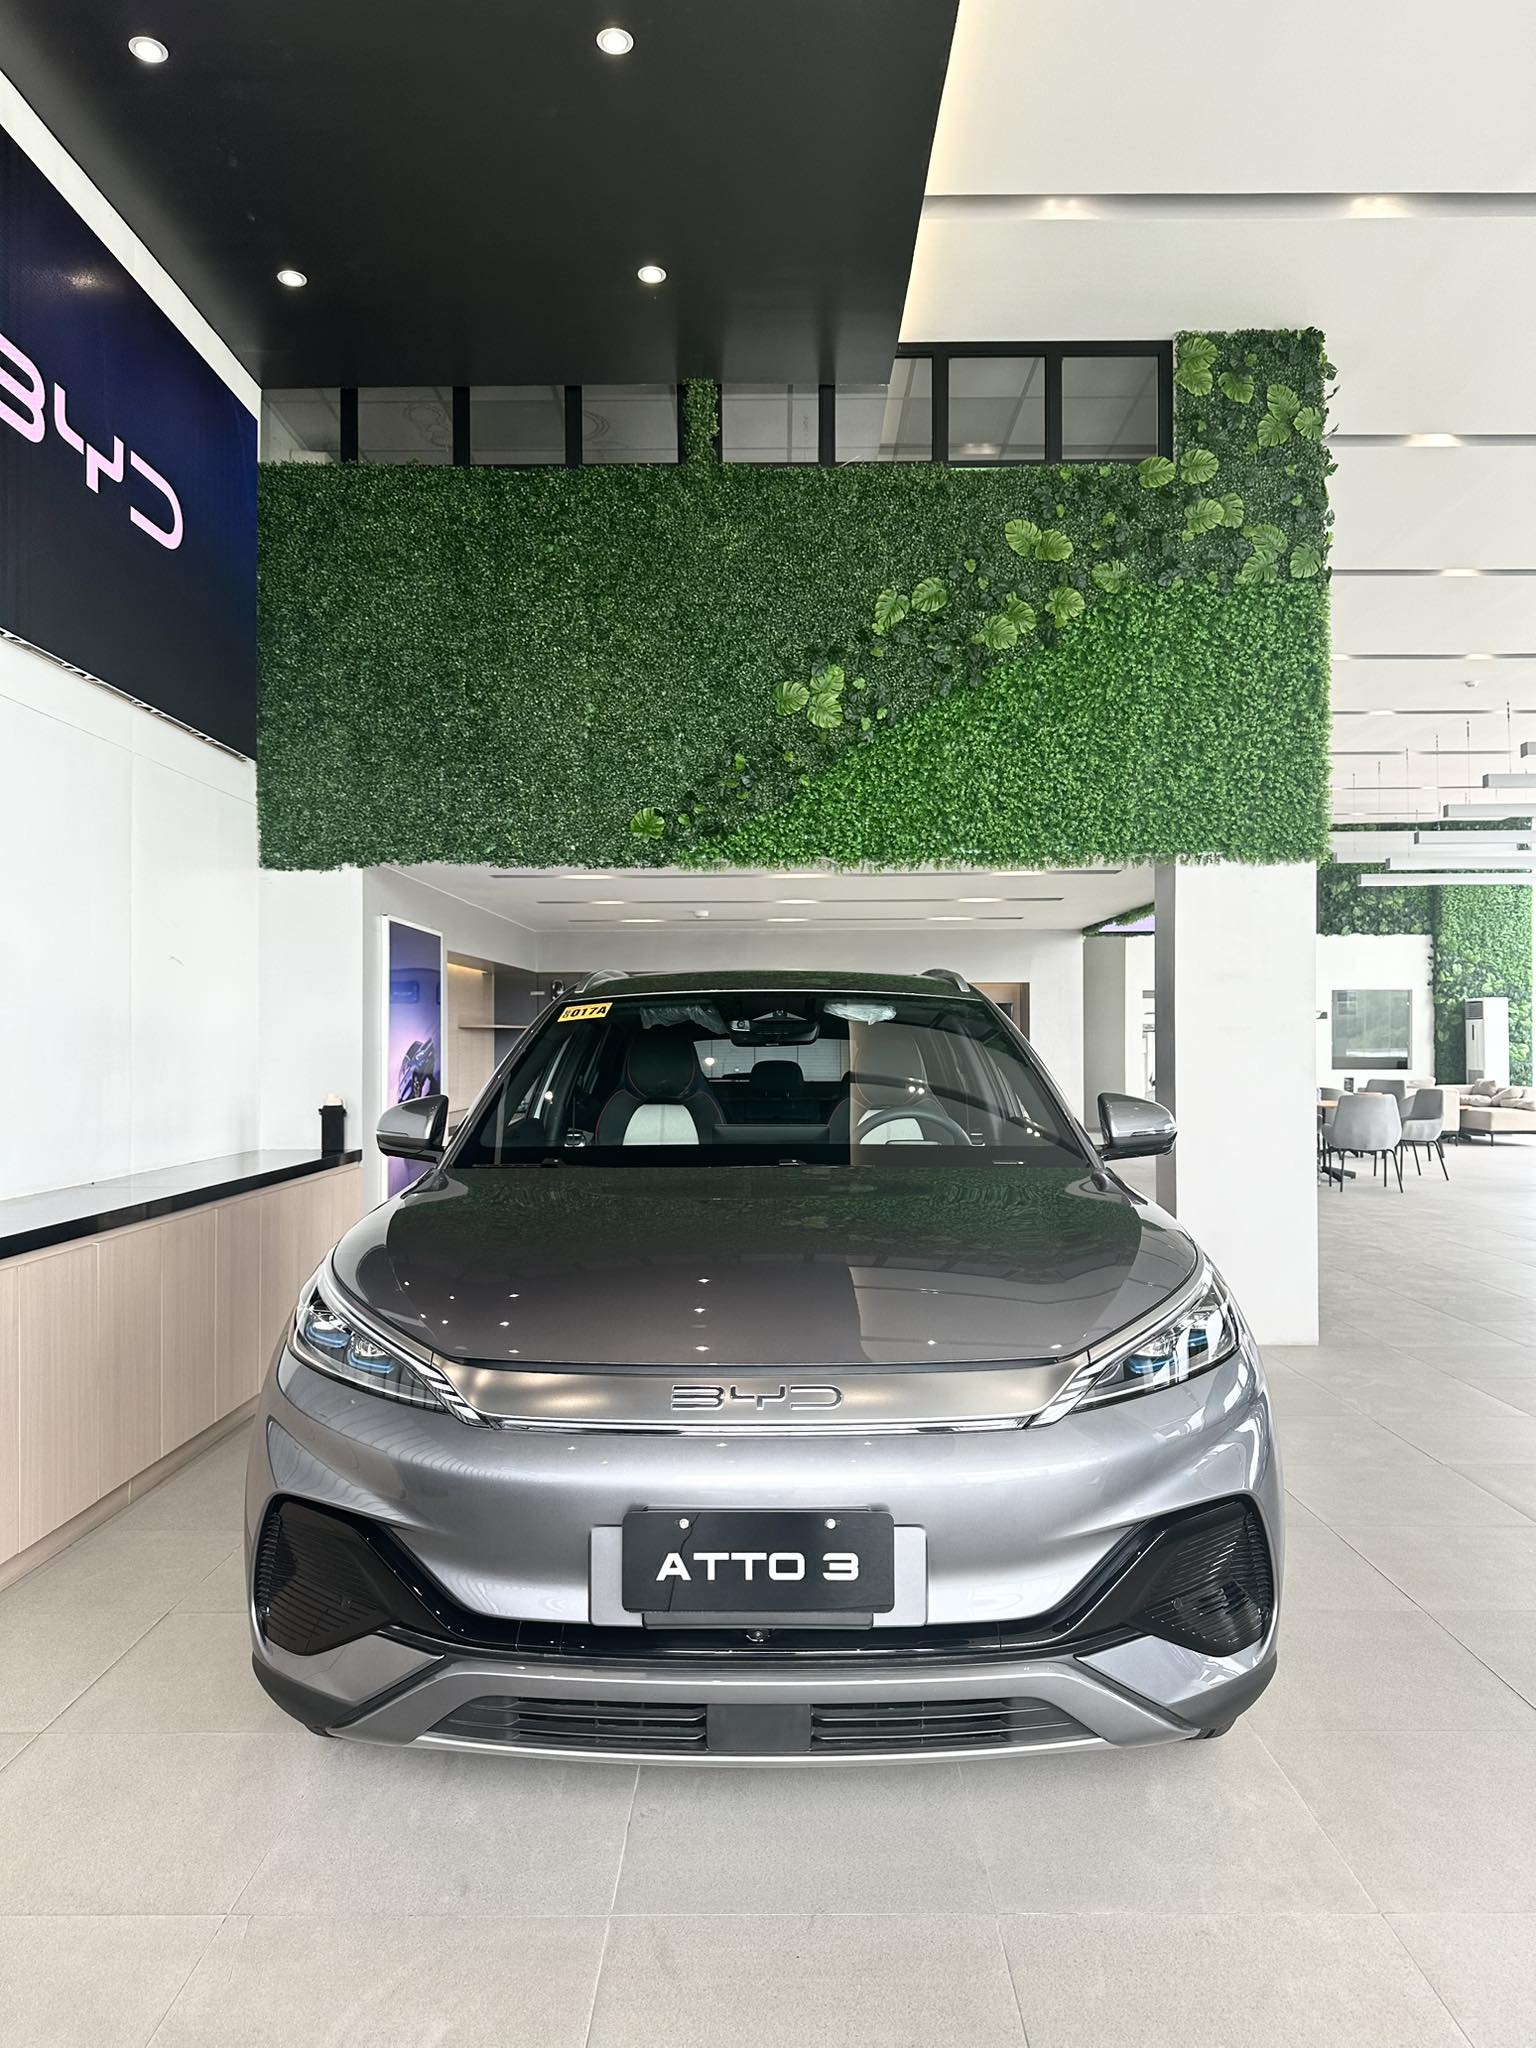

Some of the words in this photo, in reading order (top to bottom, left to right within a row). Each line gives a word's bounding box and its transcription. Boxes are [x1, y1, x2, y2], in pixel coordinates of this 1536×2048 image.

[570, 1006, 607, 1017] 017A
[671, 1384, 843, 1411] BYD
[655, 1552, 806, 1581] ATTO
[822, 1552, 860, 1581] 3
